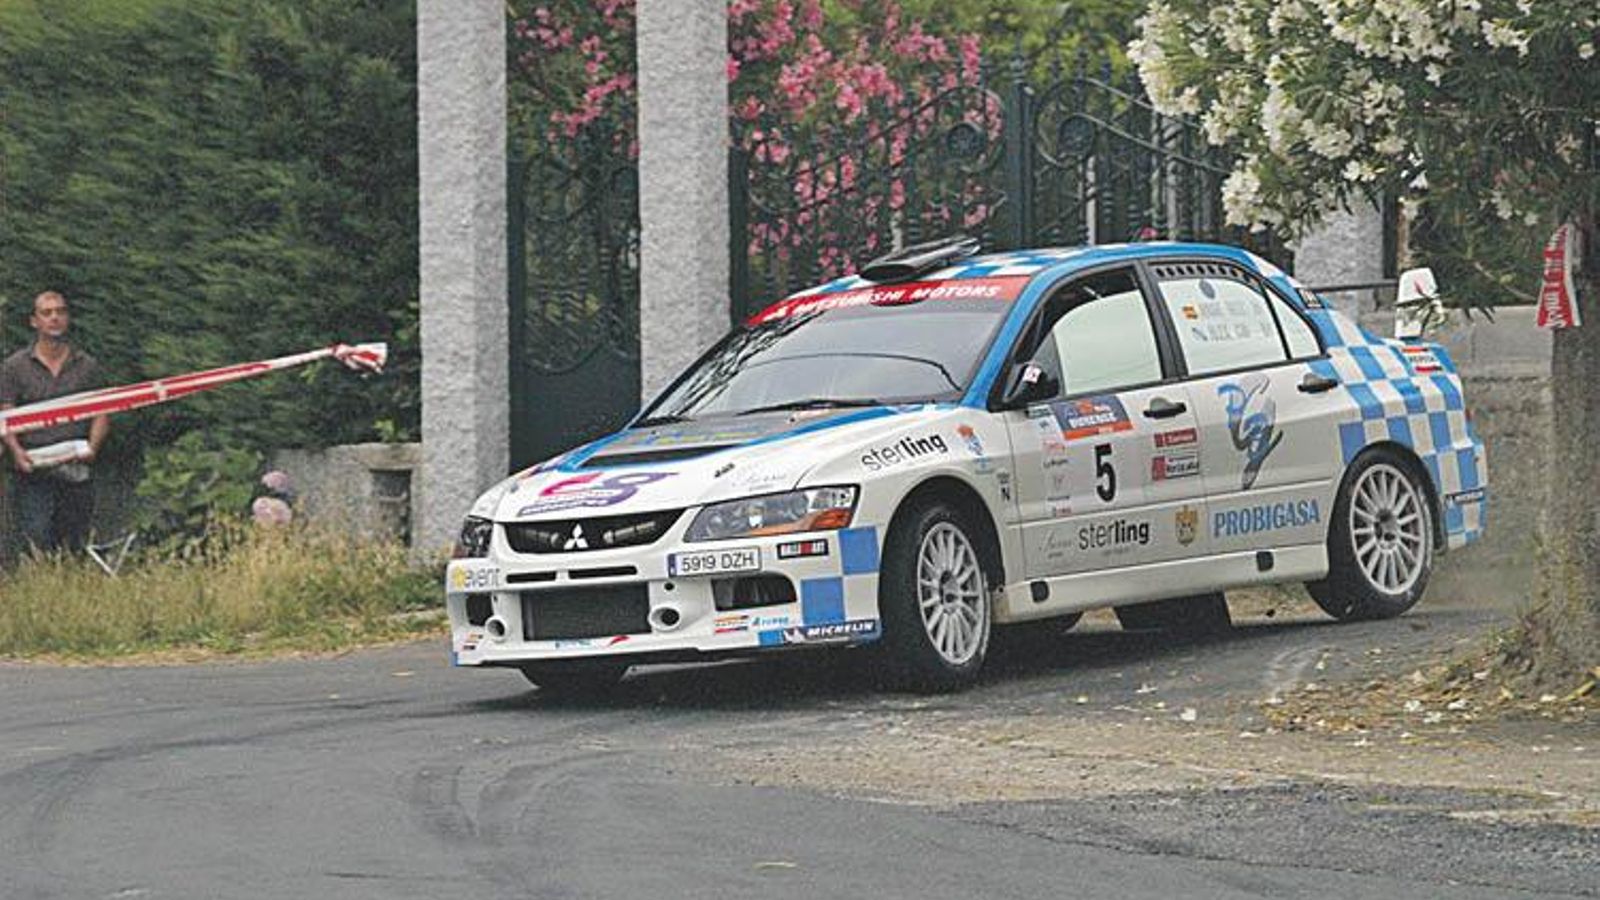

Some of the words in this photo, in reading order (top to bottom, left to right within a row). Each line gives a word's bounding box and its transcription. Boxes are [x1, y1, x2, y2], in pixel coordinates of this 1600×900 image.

[909, 285, 1001, 299] MOTORS
[861, 433, 949, 471] sterling
[1094, 443, 1116, 503] 5
[1213, 499, 1320, 538] PROBIGASA
[1078, 520, 1150, 550] sterling
[681, 556, 716, 573] 5919
[721, 552, 755, 569] DZH
[807, 622, 874, 637] MICHELIN
